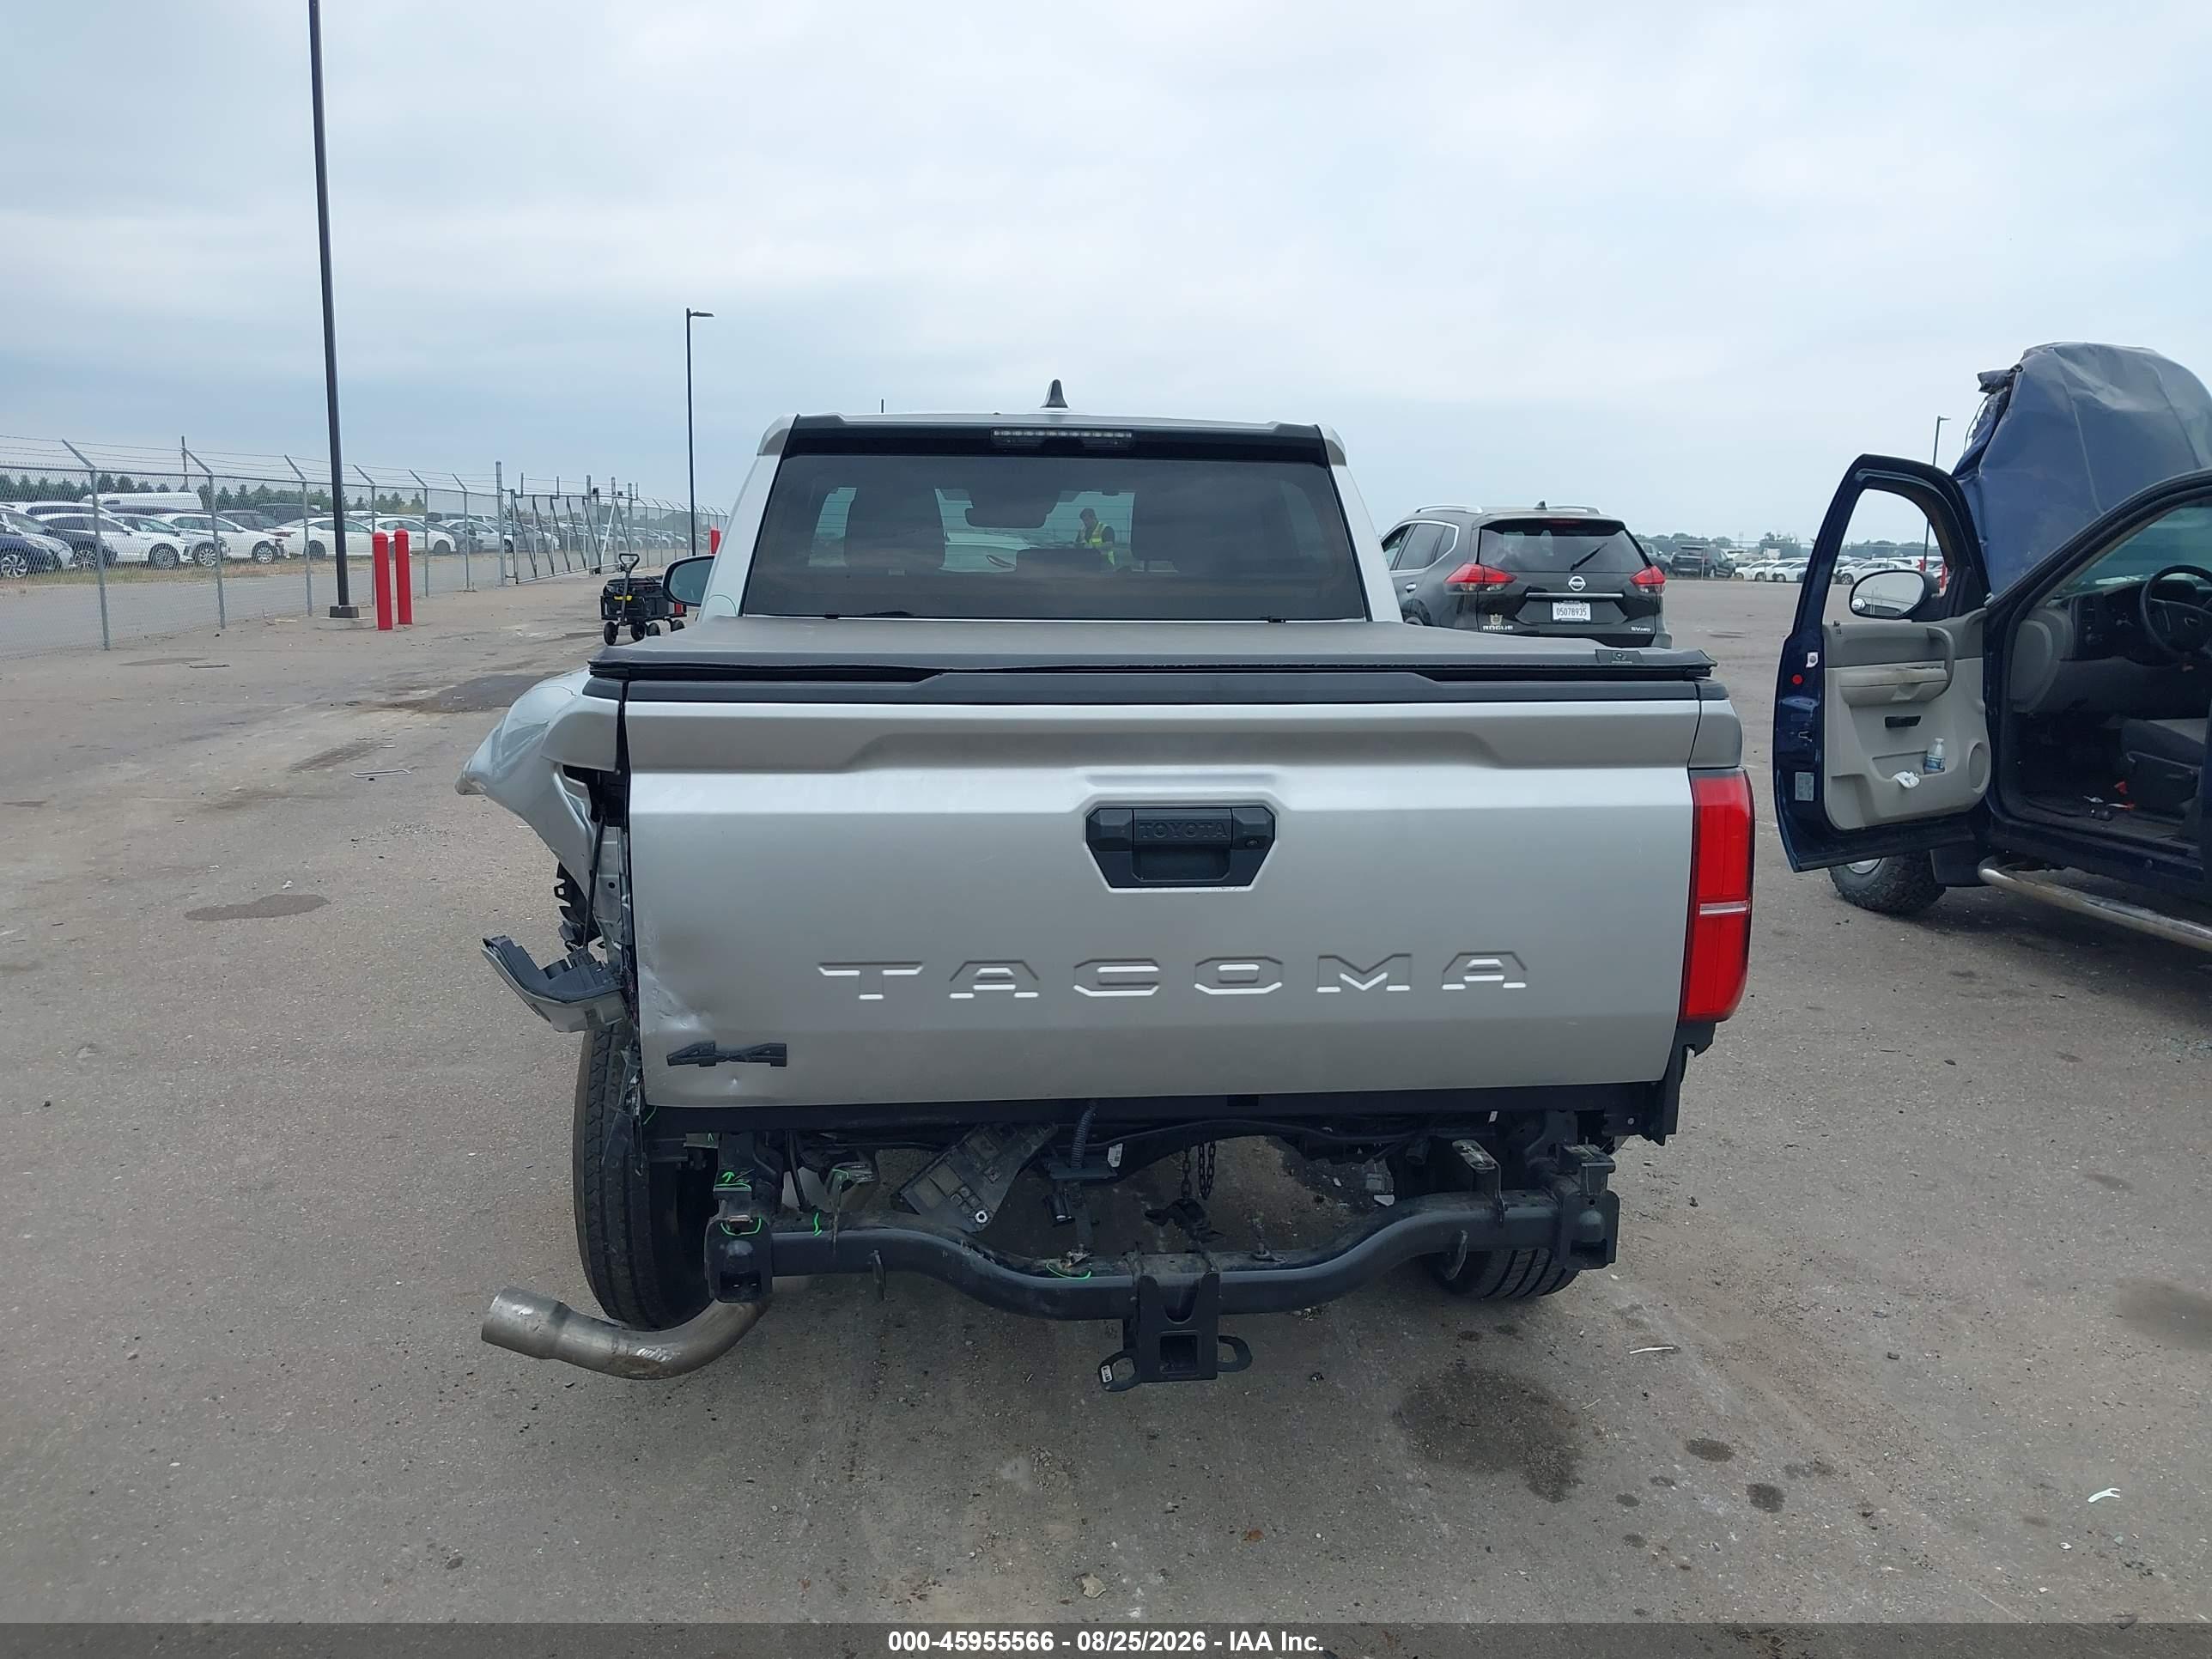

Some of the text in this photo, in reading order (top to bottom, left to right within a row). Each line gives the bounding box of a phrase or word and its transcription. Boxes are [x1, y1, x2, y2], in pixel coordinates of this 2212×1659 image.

[1556, 607, 1587, 617] 05078935
[1139, 821, 1228, 838] TOYOTA
[818, 951, 1528, 1001] TACOMA
